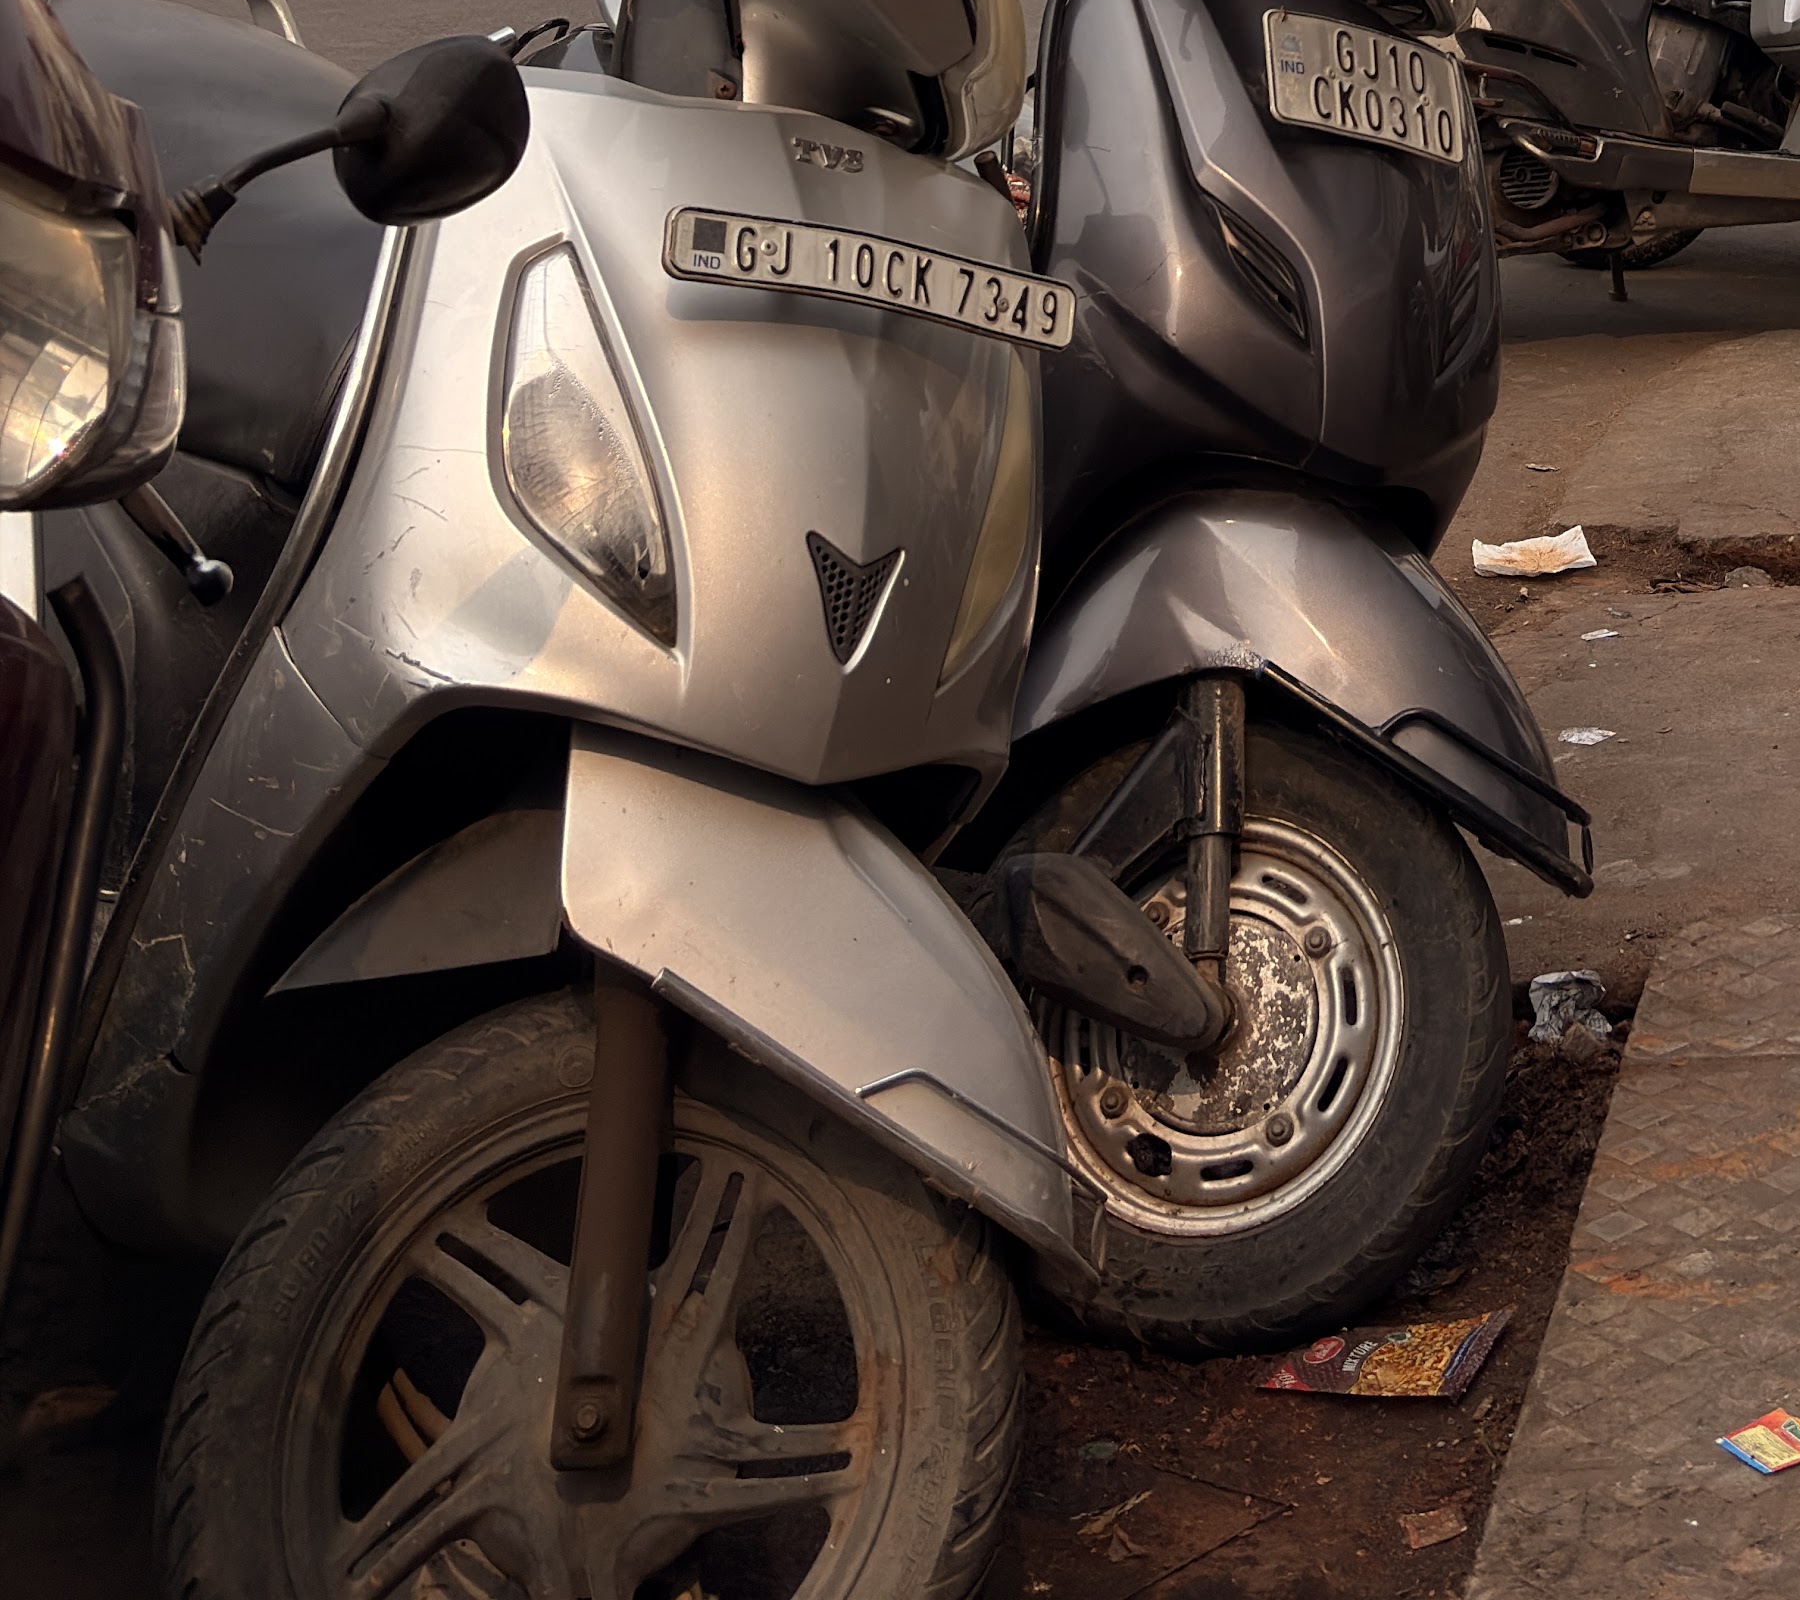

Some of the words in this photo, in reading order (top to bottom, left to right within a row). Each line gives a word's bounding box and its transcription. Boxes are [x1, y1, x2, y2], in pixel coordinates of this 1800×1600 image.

[1279, 59, 1306, 76] IND
[1335, 29, 1426, 95] GJ10
[1313, 76, 1454, 154] CK0310
[792, 136, 865, 174] TVS
[692, 252, 722, 271] IND
[735, 226, 793, 276] GJ
[825, 237, 932, 306] 10CK
[957, 267, 1059, 336] 7349
[1341, 1340, 1379, 1373] MIXTURE
